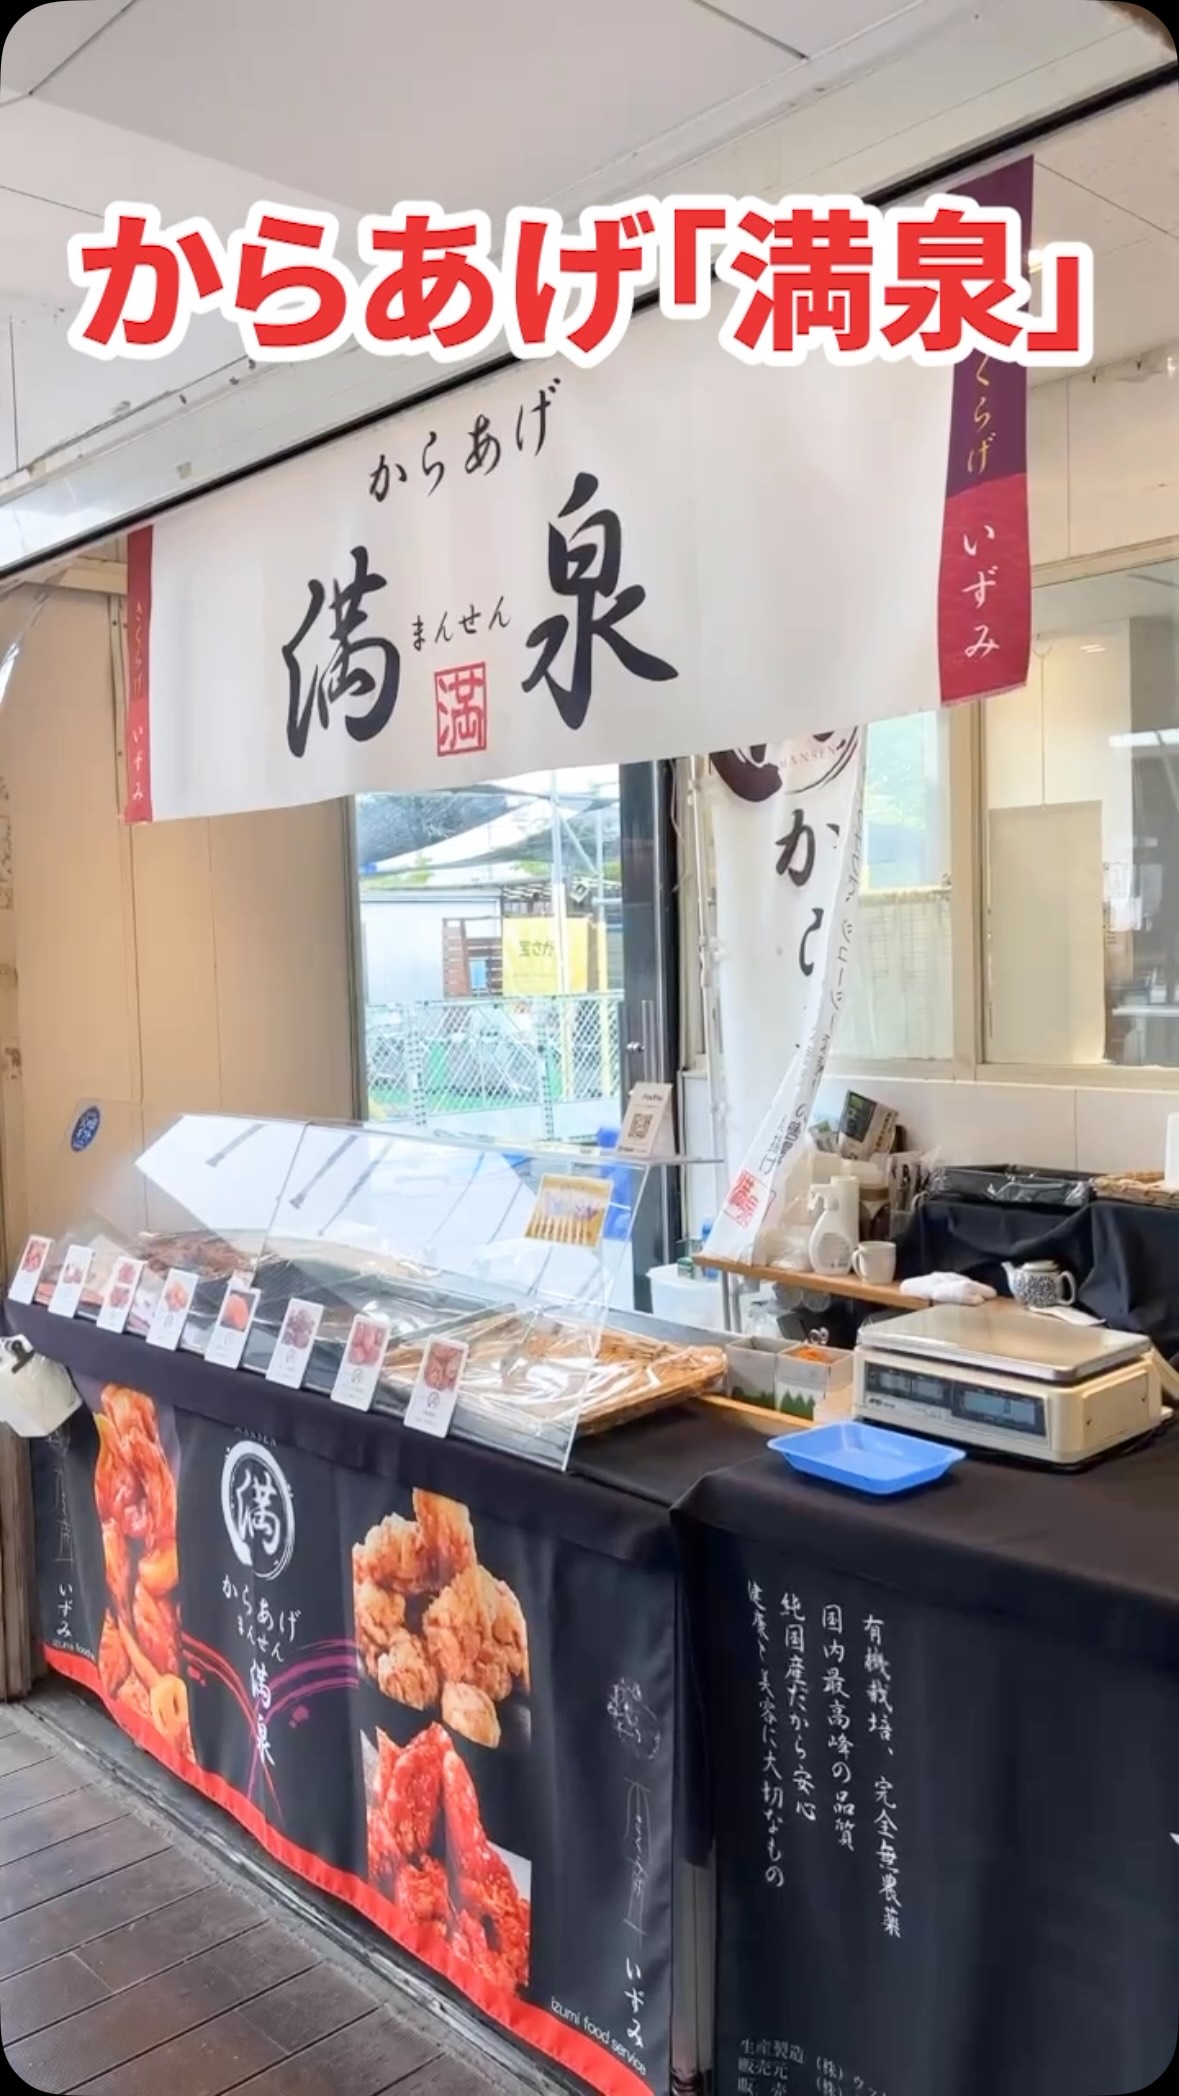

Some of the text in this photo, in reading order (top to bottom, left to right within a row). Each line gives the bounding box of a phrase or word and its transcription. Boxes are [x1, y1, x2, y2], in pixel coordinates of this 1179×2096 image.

[368, 377, 562, 503] からあげ
[411, 595, 513, 652] まんせん
[961, 524, 1000, 659] いずみ
[436, 664, 486, 754] 満
[235, 1468, 281, 1556] 満
[56, 1582, 74, 1640] いずみ
[221, 1573, 302, 1643] からあげ
[249, 1660, 276, 1767] 満泉
[780, 1590, 817, 1822] 純国産だから安心
[821, 1602, 856, 1852] 国内最高峰の品質
[550, 1995, 648, 2076] izumi food service
[623, 1955, 646, 2049] いずみ
